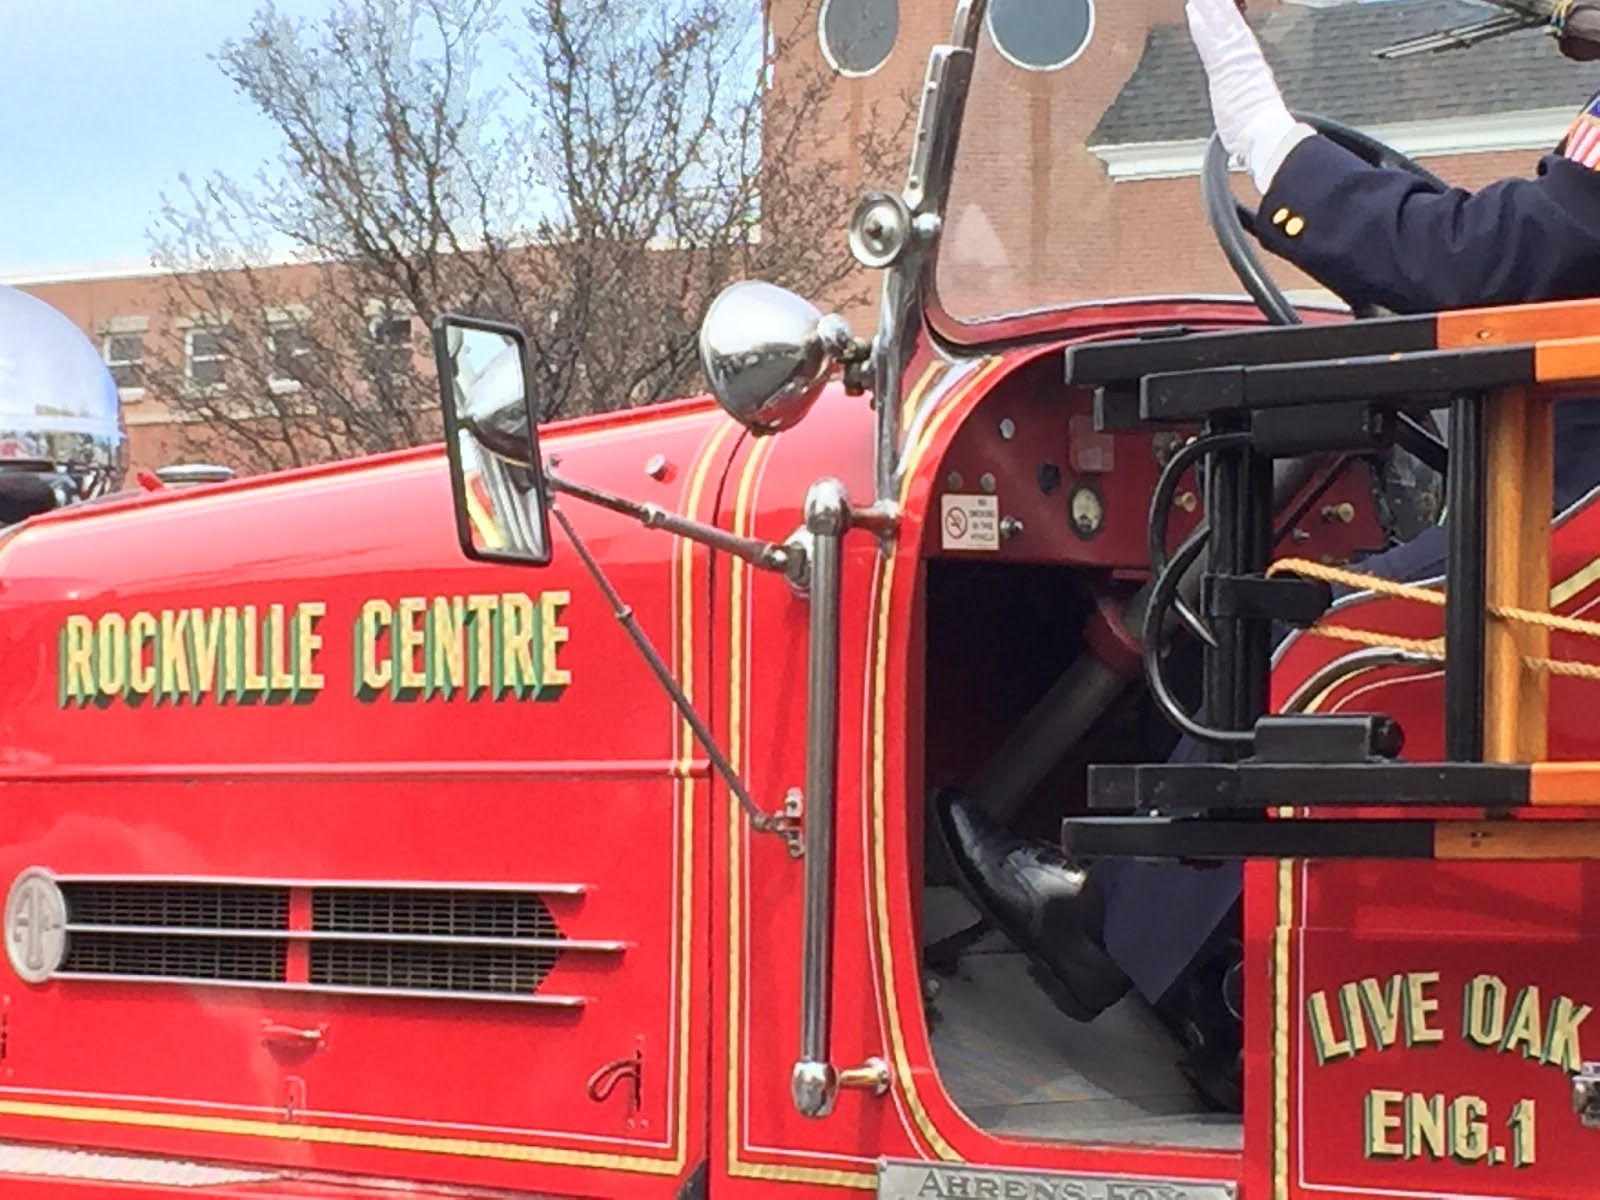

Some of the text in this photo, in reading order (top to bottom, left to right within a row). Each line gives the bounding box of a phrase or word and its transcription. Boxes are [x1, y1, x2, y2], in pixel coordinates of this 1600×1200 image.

[59, 590, 572, 709] ROCKVILLE CENTRE
[1307, 971, 1593, 1074] LIVE OAK
